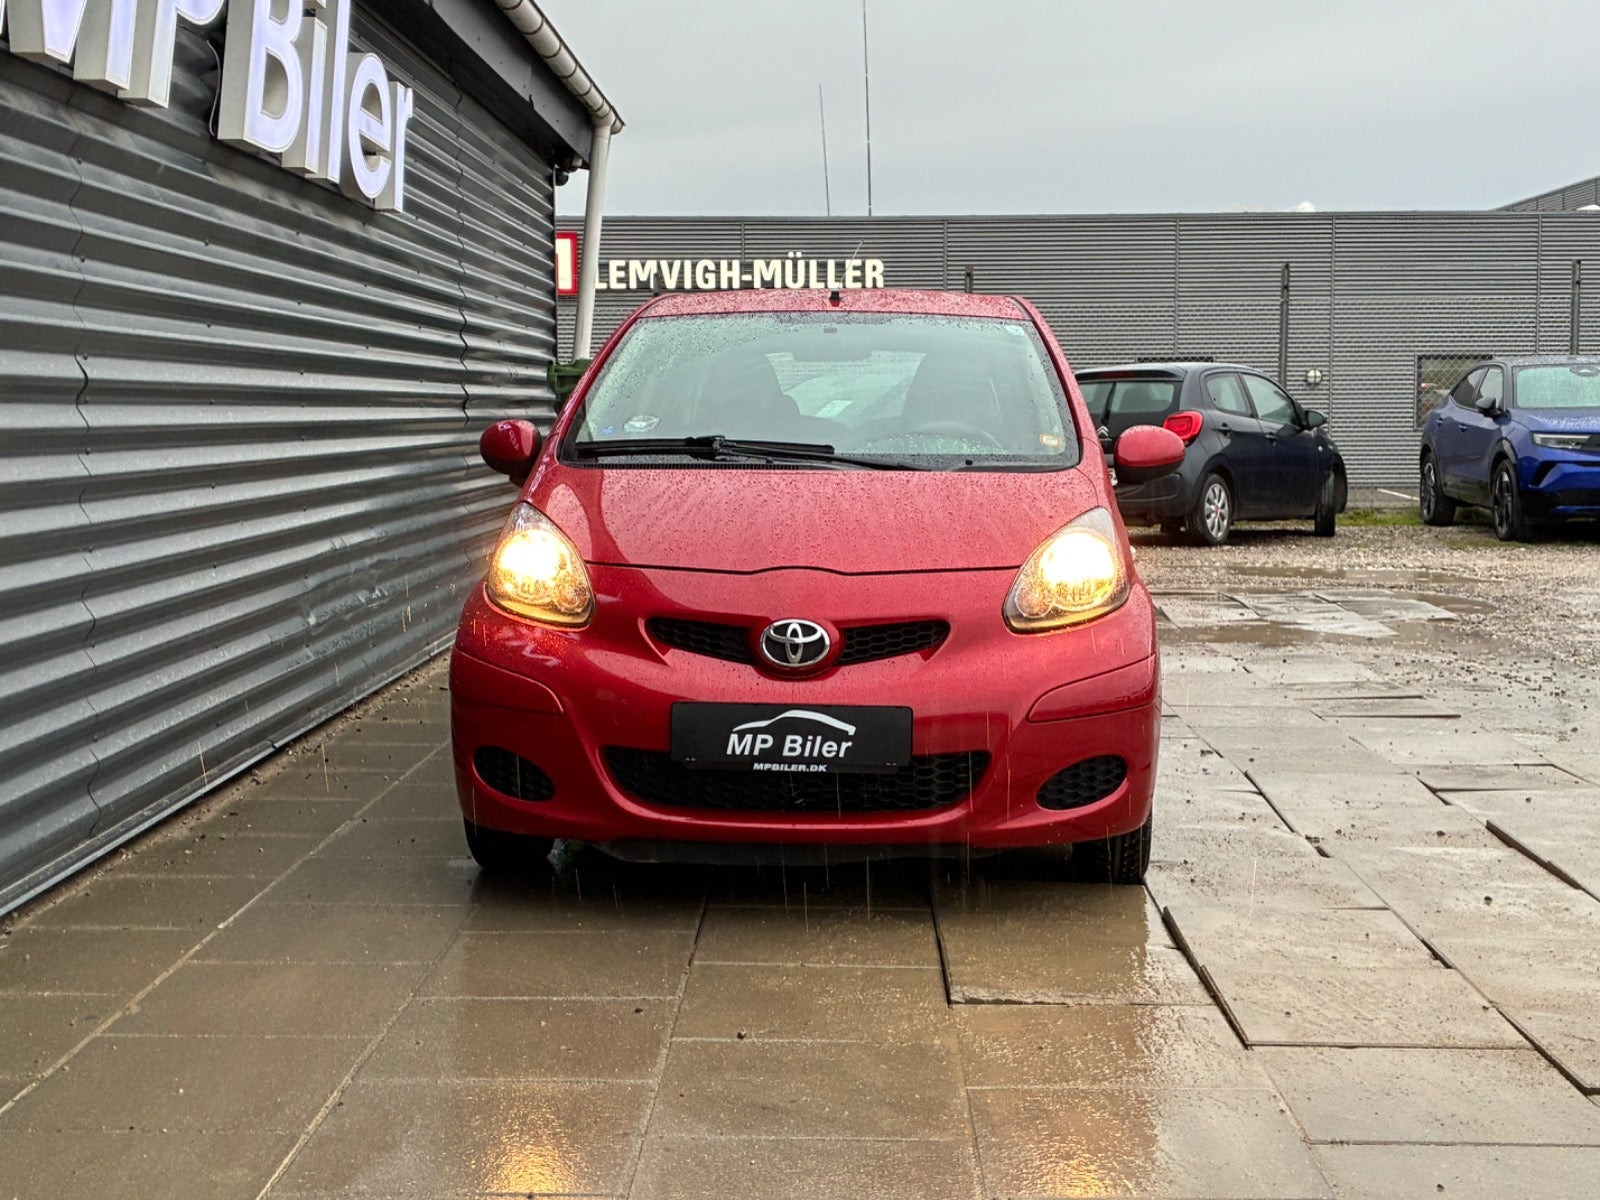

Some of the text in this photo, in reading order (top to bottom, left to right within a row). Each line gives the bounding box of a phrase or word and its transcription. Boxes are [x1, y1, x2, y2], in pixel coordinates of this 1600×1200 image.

[243, 0, 414, 212] Biler
[726, 733, 853, 758] MP Biler
[753, 762, 828, 772] MPBILER.DK
